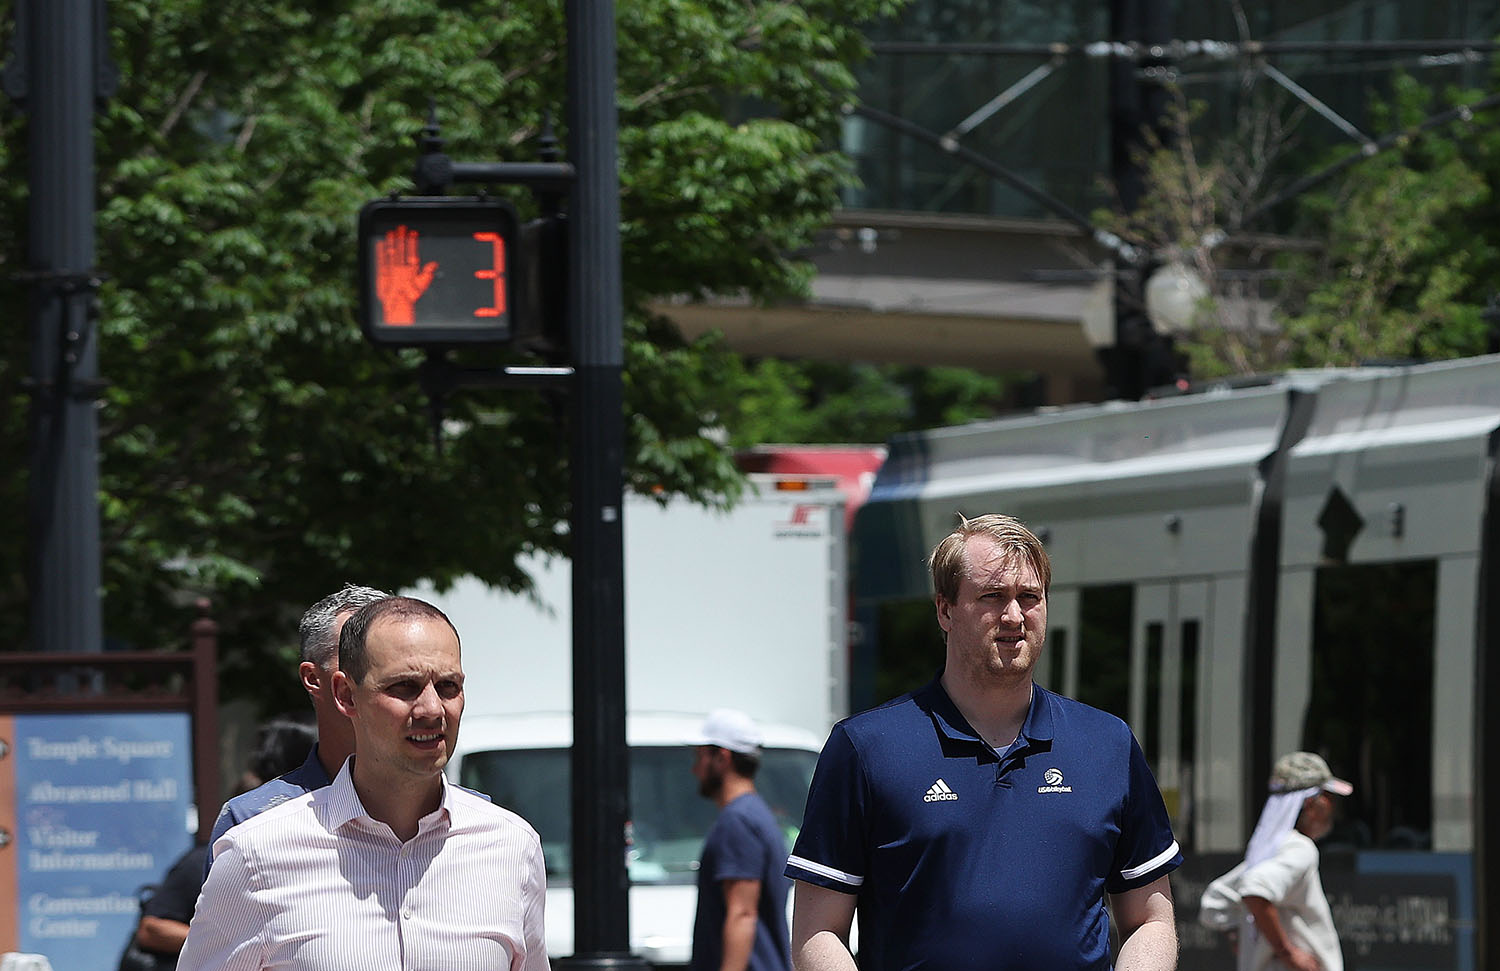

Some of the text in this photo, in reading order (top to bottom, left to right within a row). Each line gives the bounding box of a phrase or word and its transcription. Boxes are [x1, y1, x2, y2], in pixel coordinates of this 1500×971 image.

[474, 231, 506, 318] 3
[28, 736, 173, 764] Temple Square
[132, 778, 177, 802] Hall
[923, 792, 958, 803] adidas
[28, 826, 100, 847] Visitor
[29, 848, 154, 872] Information
[29, 893, 140, 916] Conventio
[29, 917, 99, 939] Center
